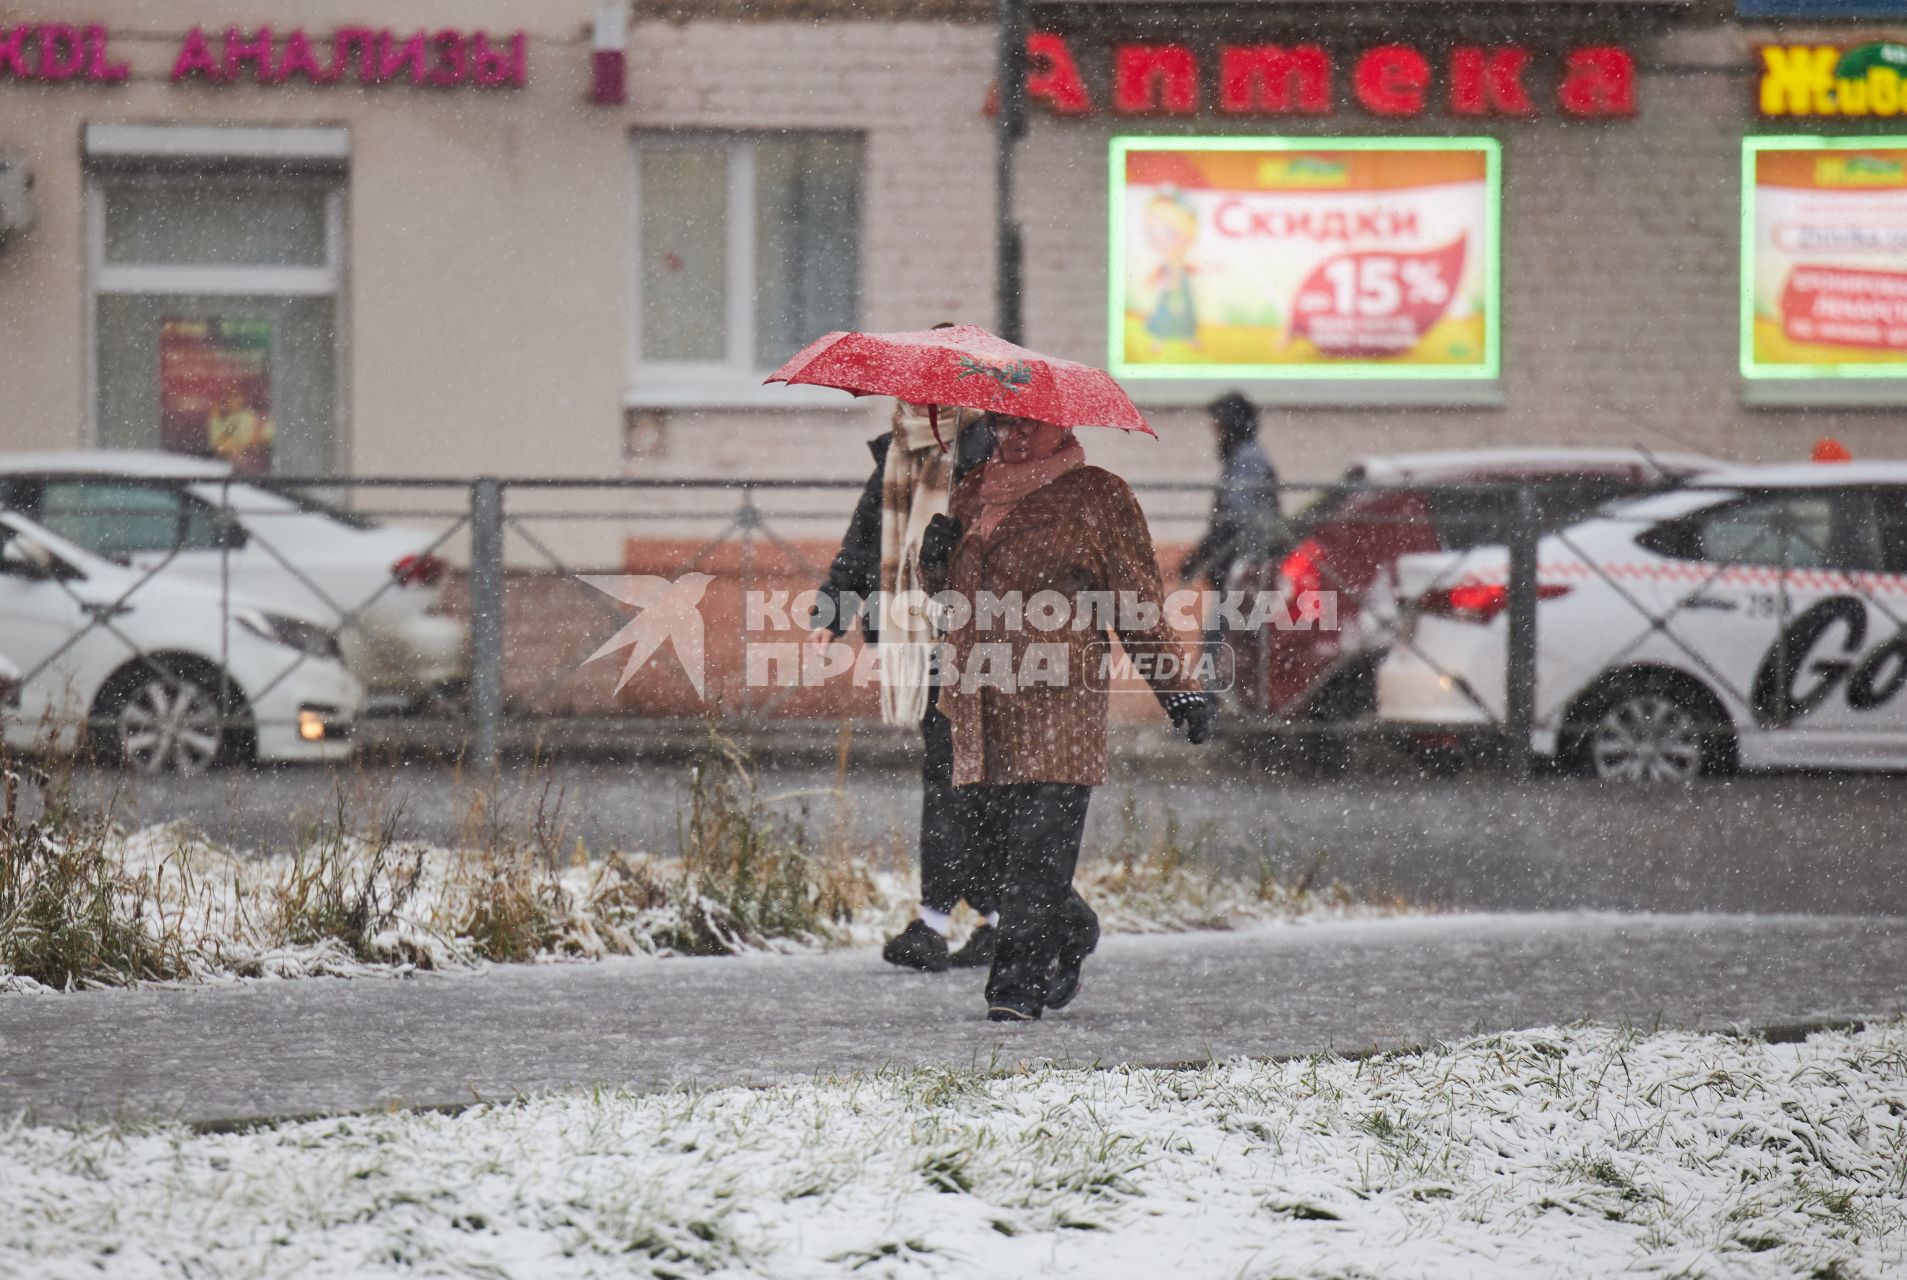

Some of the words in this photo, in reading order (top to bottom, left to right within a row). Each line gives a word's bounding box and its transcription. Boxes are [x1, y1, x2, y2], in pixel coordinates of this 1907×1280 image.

[172, 26, 528, 87] АНАЛИЗЫ
[1760, 45, 1907, 116] Жив
[1214, 199, 1418, 241] Скидки
[1323, 256, 1449, 316] 15%
